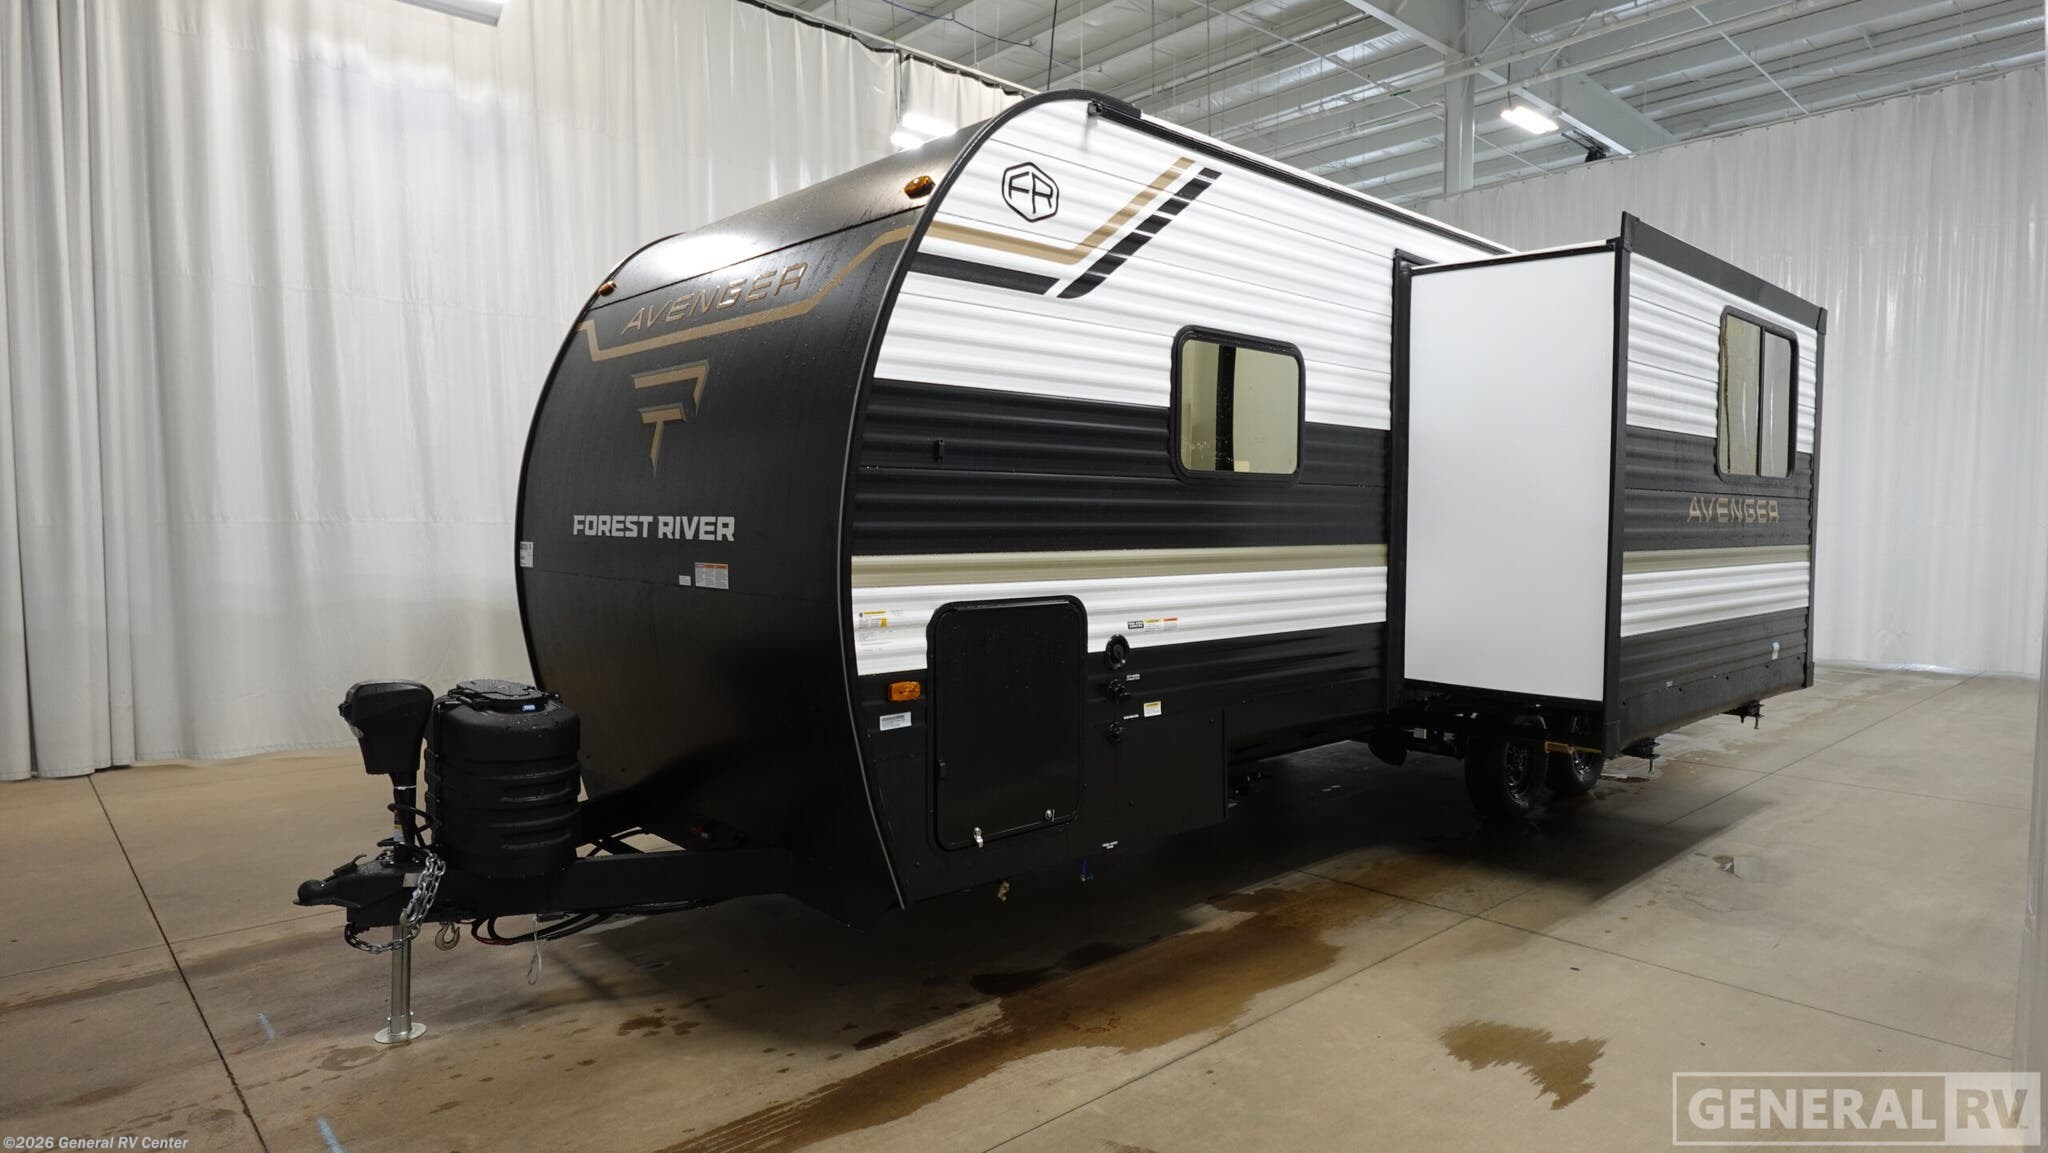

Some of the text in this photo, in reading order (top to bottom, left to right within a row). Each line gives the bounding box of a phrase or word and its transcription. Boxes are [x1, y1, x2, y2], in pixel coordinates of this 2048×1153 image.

[621, 261, 808, 335] AVENGER
[1687, 496, 1780, 523] AVENGER
[573, 515, 735, 541] FOREST RIVER
